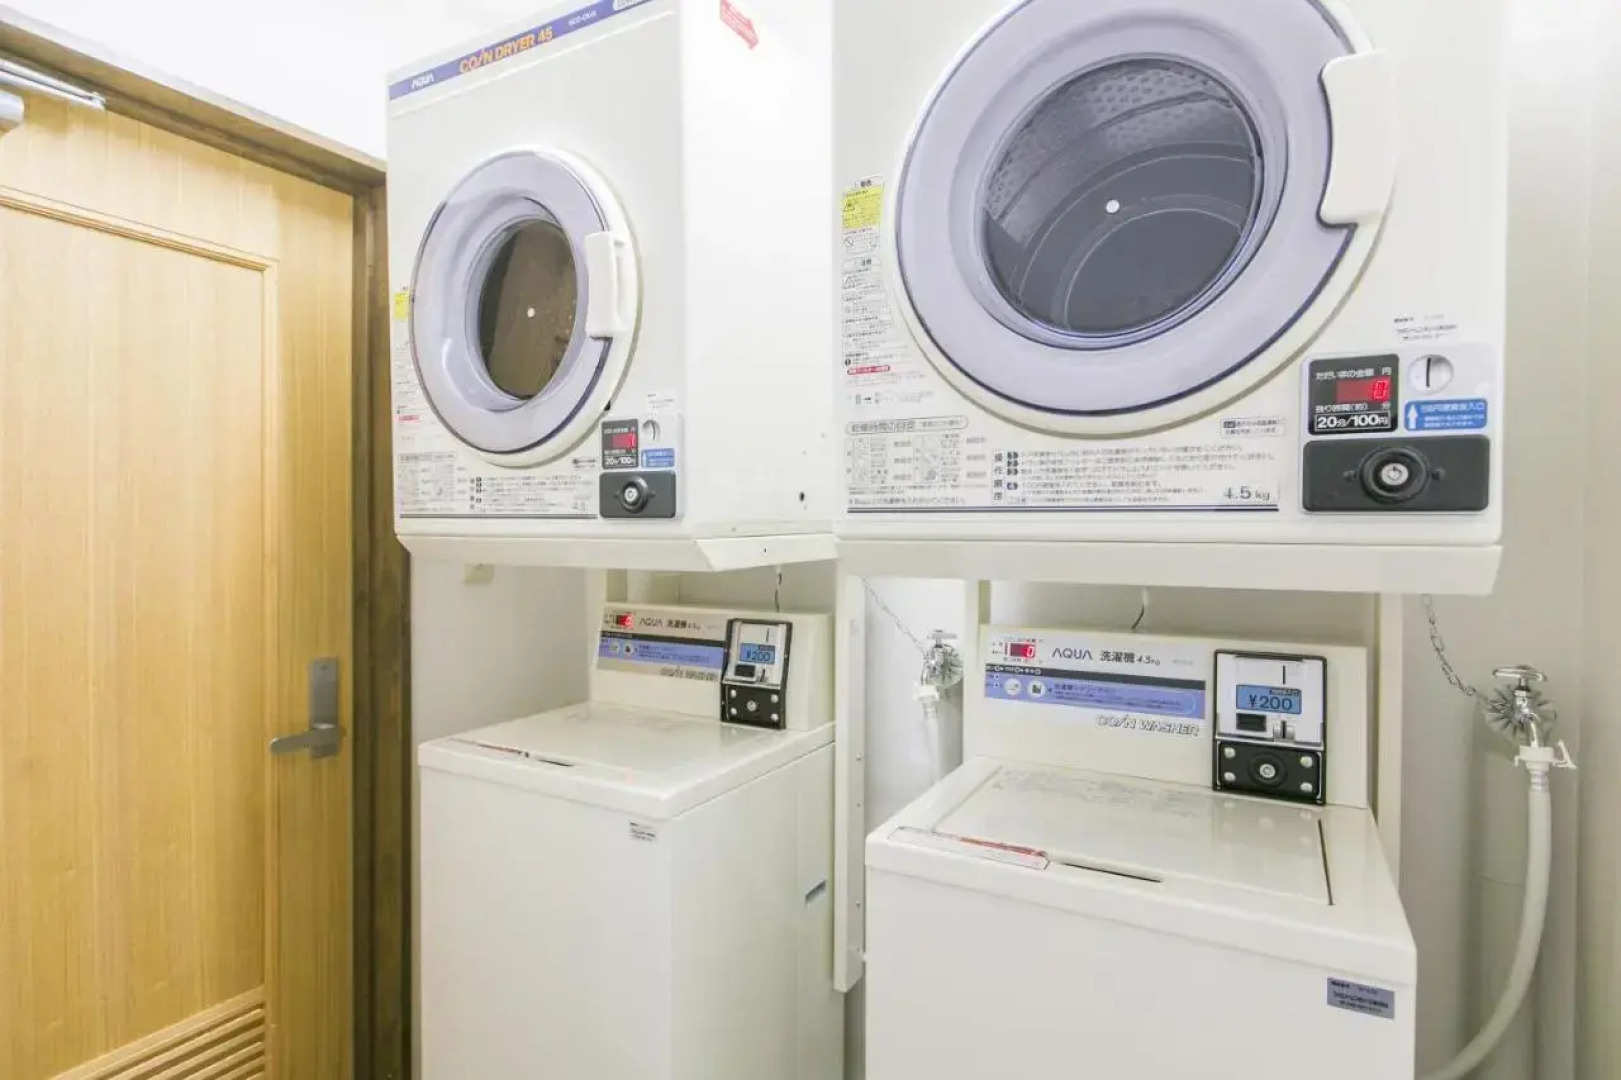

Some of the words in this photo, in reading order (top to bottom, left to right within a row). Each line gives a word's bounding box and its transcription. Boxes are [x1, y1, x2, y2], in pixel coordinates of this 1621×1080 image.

[460, 48, 494, 73] COIN
[495, 33, 535, 61] DRYER
[537, 28, 554, 45] 45
[411, 73, 434, 90] AQUA
[1316, 414, 1389, 430] 20分/100円
[638, 617, 663, 628] AQUA
[746, 649, 771, 662] ¥200
[1052, 647, 1093, 661] AQUA
[1099, 650, 1136, 663] 洗濯機
[1249, 693, 1293, 711] ¥200
[1095, 714, 1137, 729] COIN
[1139, 718, 1200, 737] WASHER
